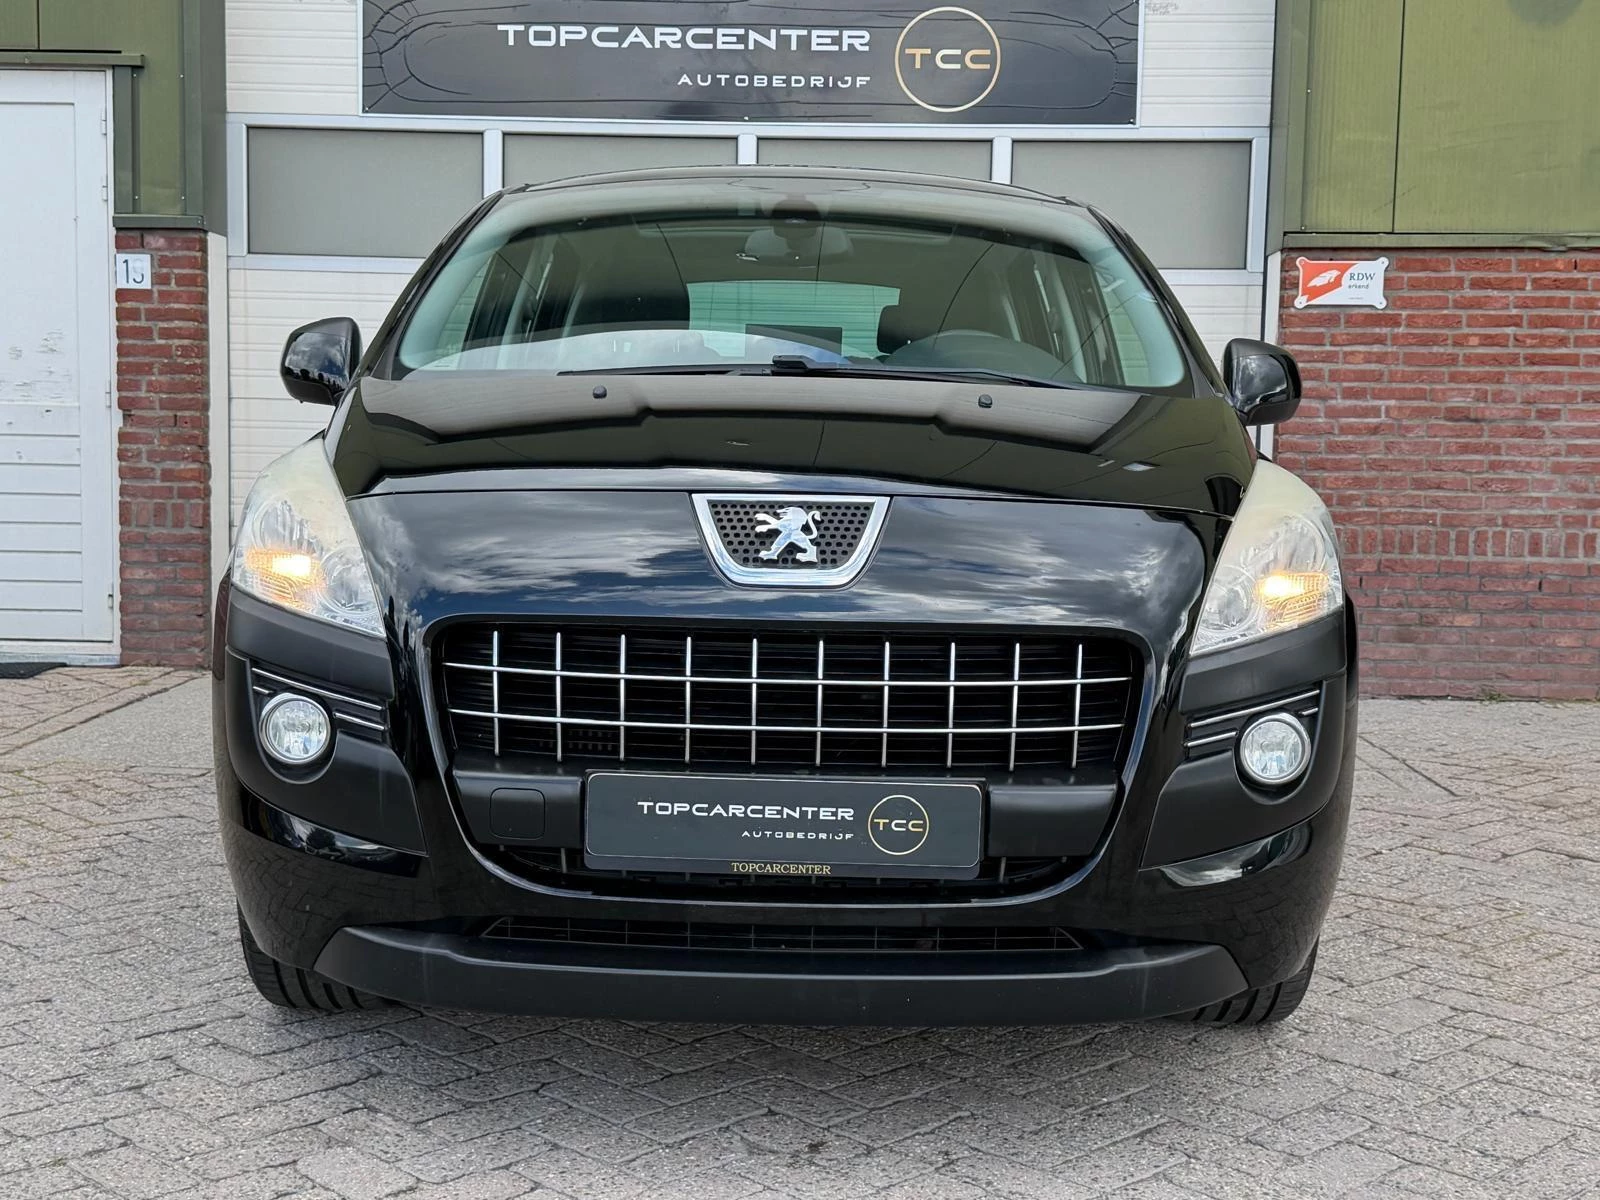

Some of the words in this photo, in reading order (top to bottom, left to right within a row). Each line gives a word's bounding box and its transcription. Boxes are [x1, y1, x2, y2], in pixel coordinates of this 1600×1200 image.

[497, 24, 870, 52] TOPCARCENTER
[904, 47, 992, 70] TCC
[676, 73, 871, 89] AUTOBEDRIJF
[1349, 272, 1376, 281] RDW
[637, 801, 855, 821] TOPCARCENTER
[873, 818, 924, 832] TCC
[741, 830, 855, 840] AUTOBEDRIJF
[731, 861, 832, 876] TOPCARCENTER
